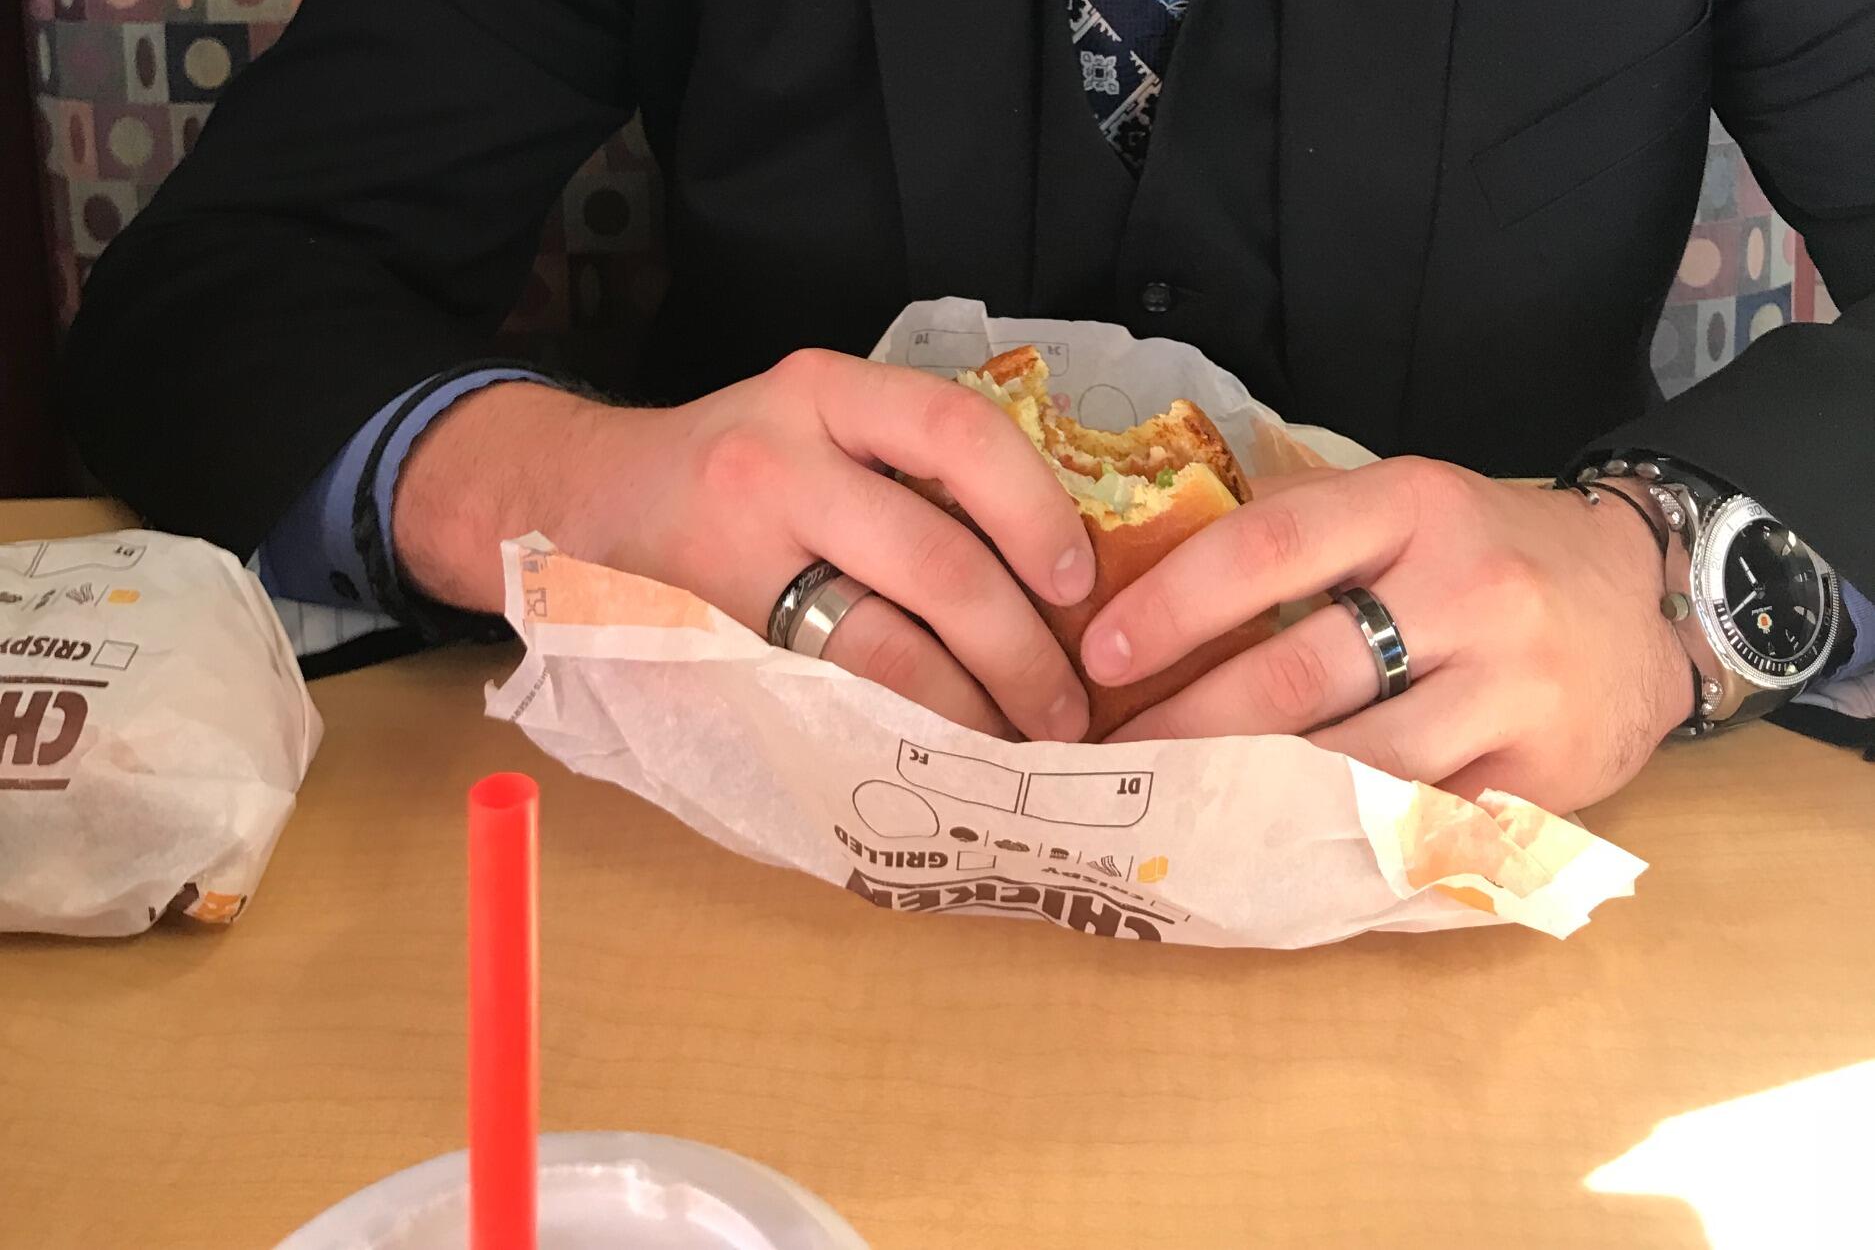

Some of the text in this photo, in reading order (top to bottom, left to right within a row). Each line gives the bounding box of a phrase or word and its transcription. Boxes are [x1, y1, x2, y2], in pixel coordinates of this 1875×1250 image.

[1747, 505, 1762, 516] 30
[115, 546, 136, 557] DT
[909, 748, 929, 766] FC
[1116, 777, 1141, 795] DT
[834, 825, 949, 869] GRILLED
